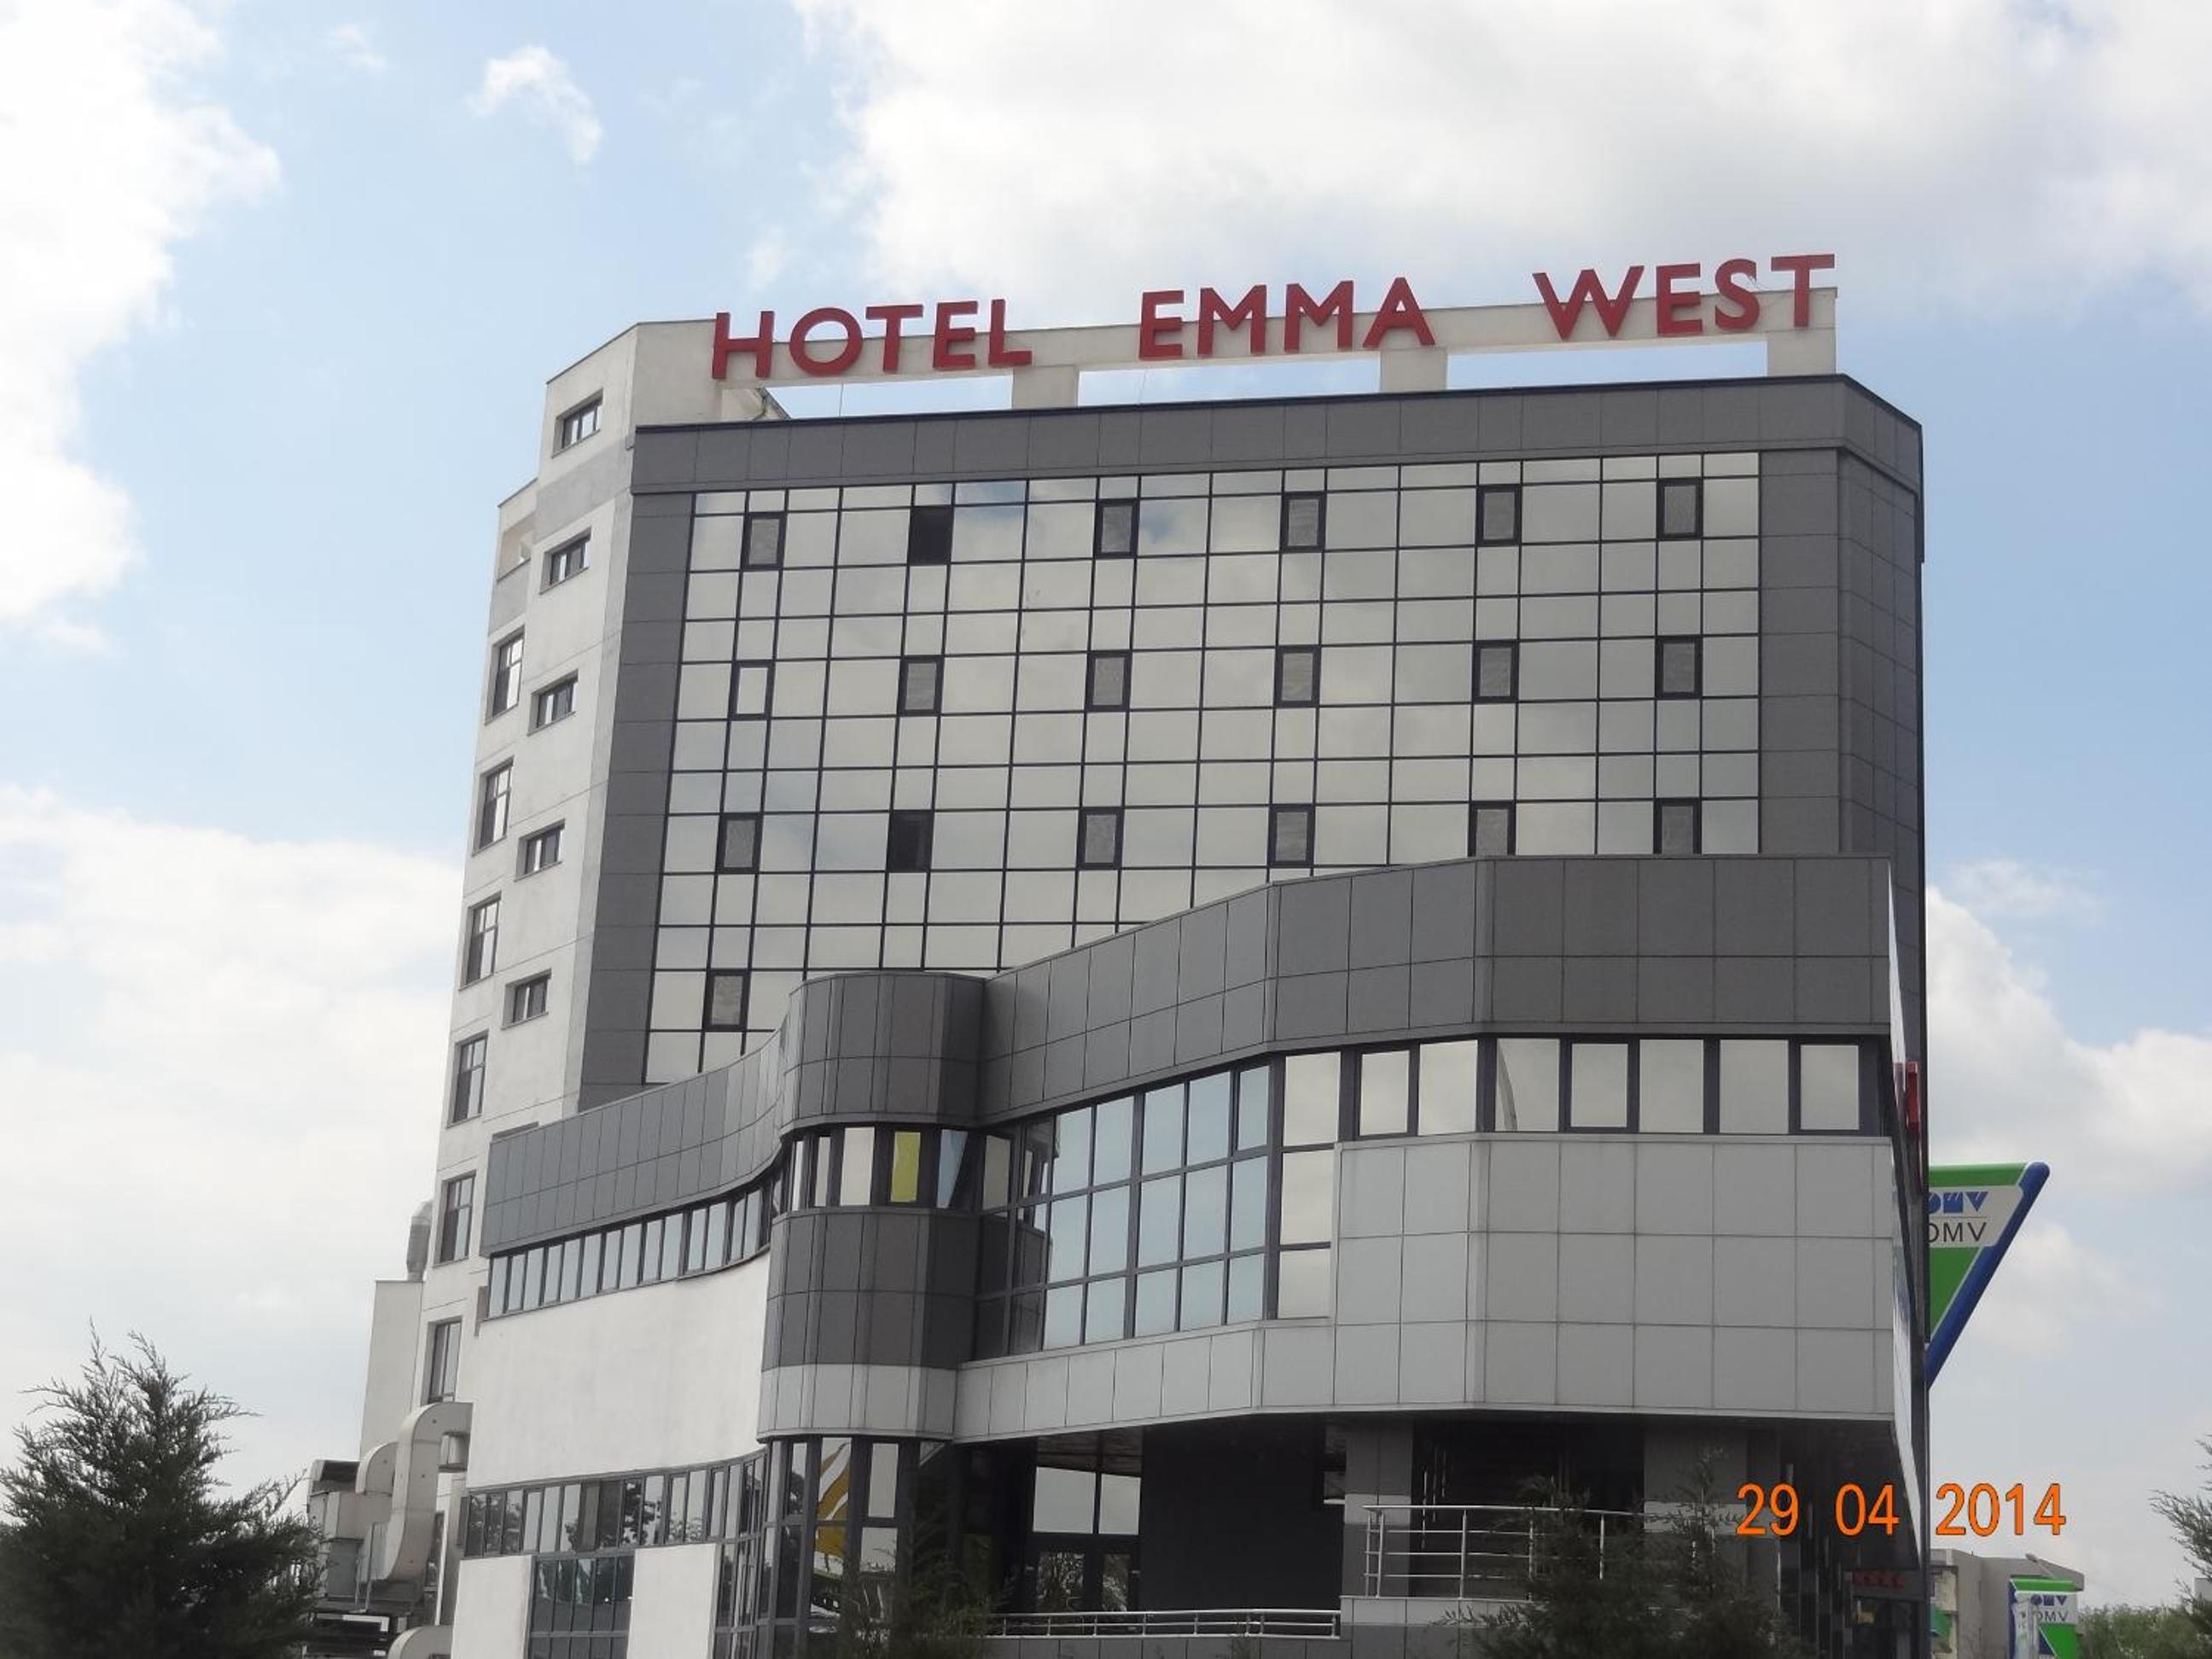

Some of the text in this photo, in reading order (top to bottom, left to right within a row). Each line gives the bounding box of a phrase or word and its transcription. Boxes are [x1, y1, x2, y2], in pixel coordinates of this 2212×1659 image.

[712, 253, 1836, 381] HOTEL EMMA WEST
